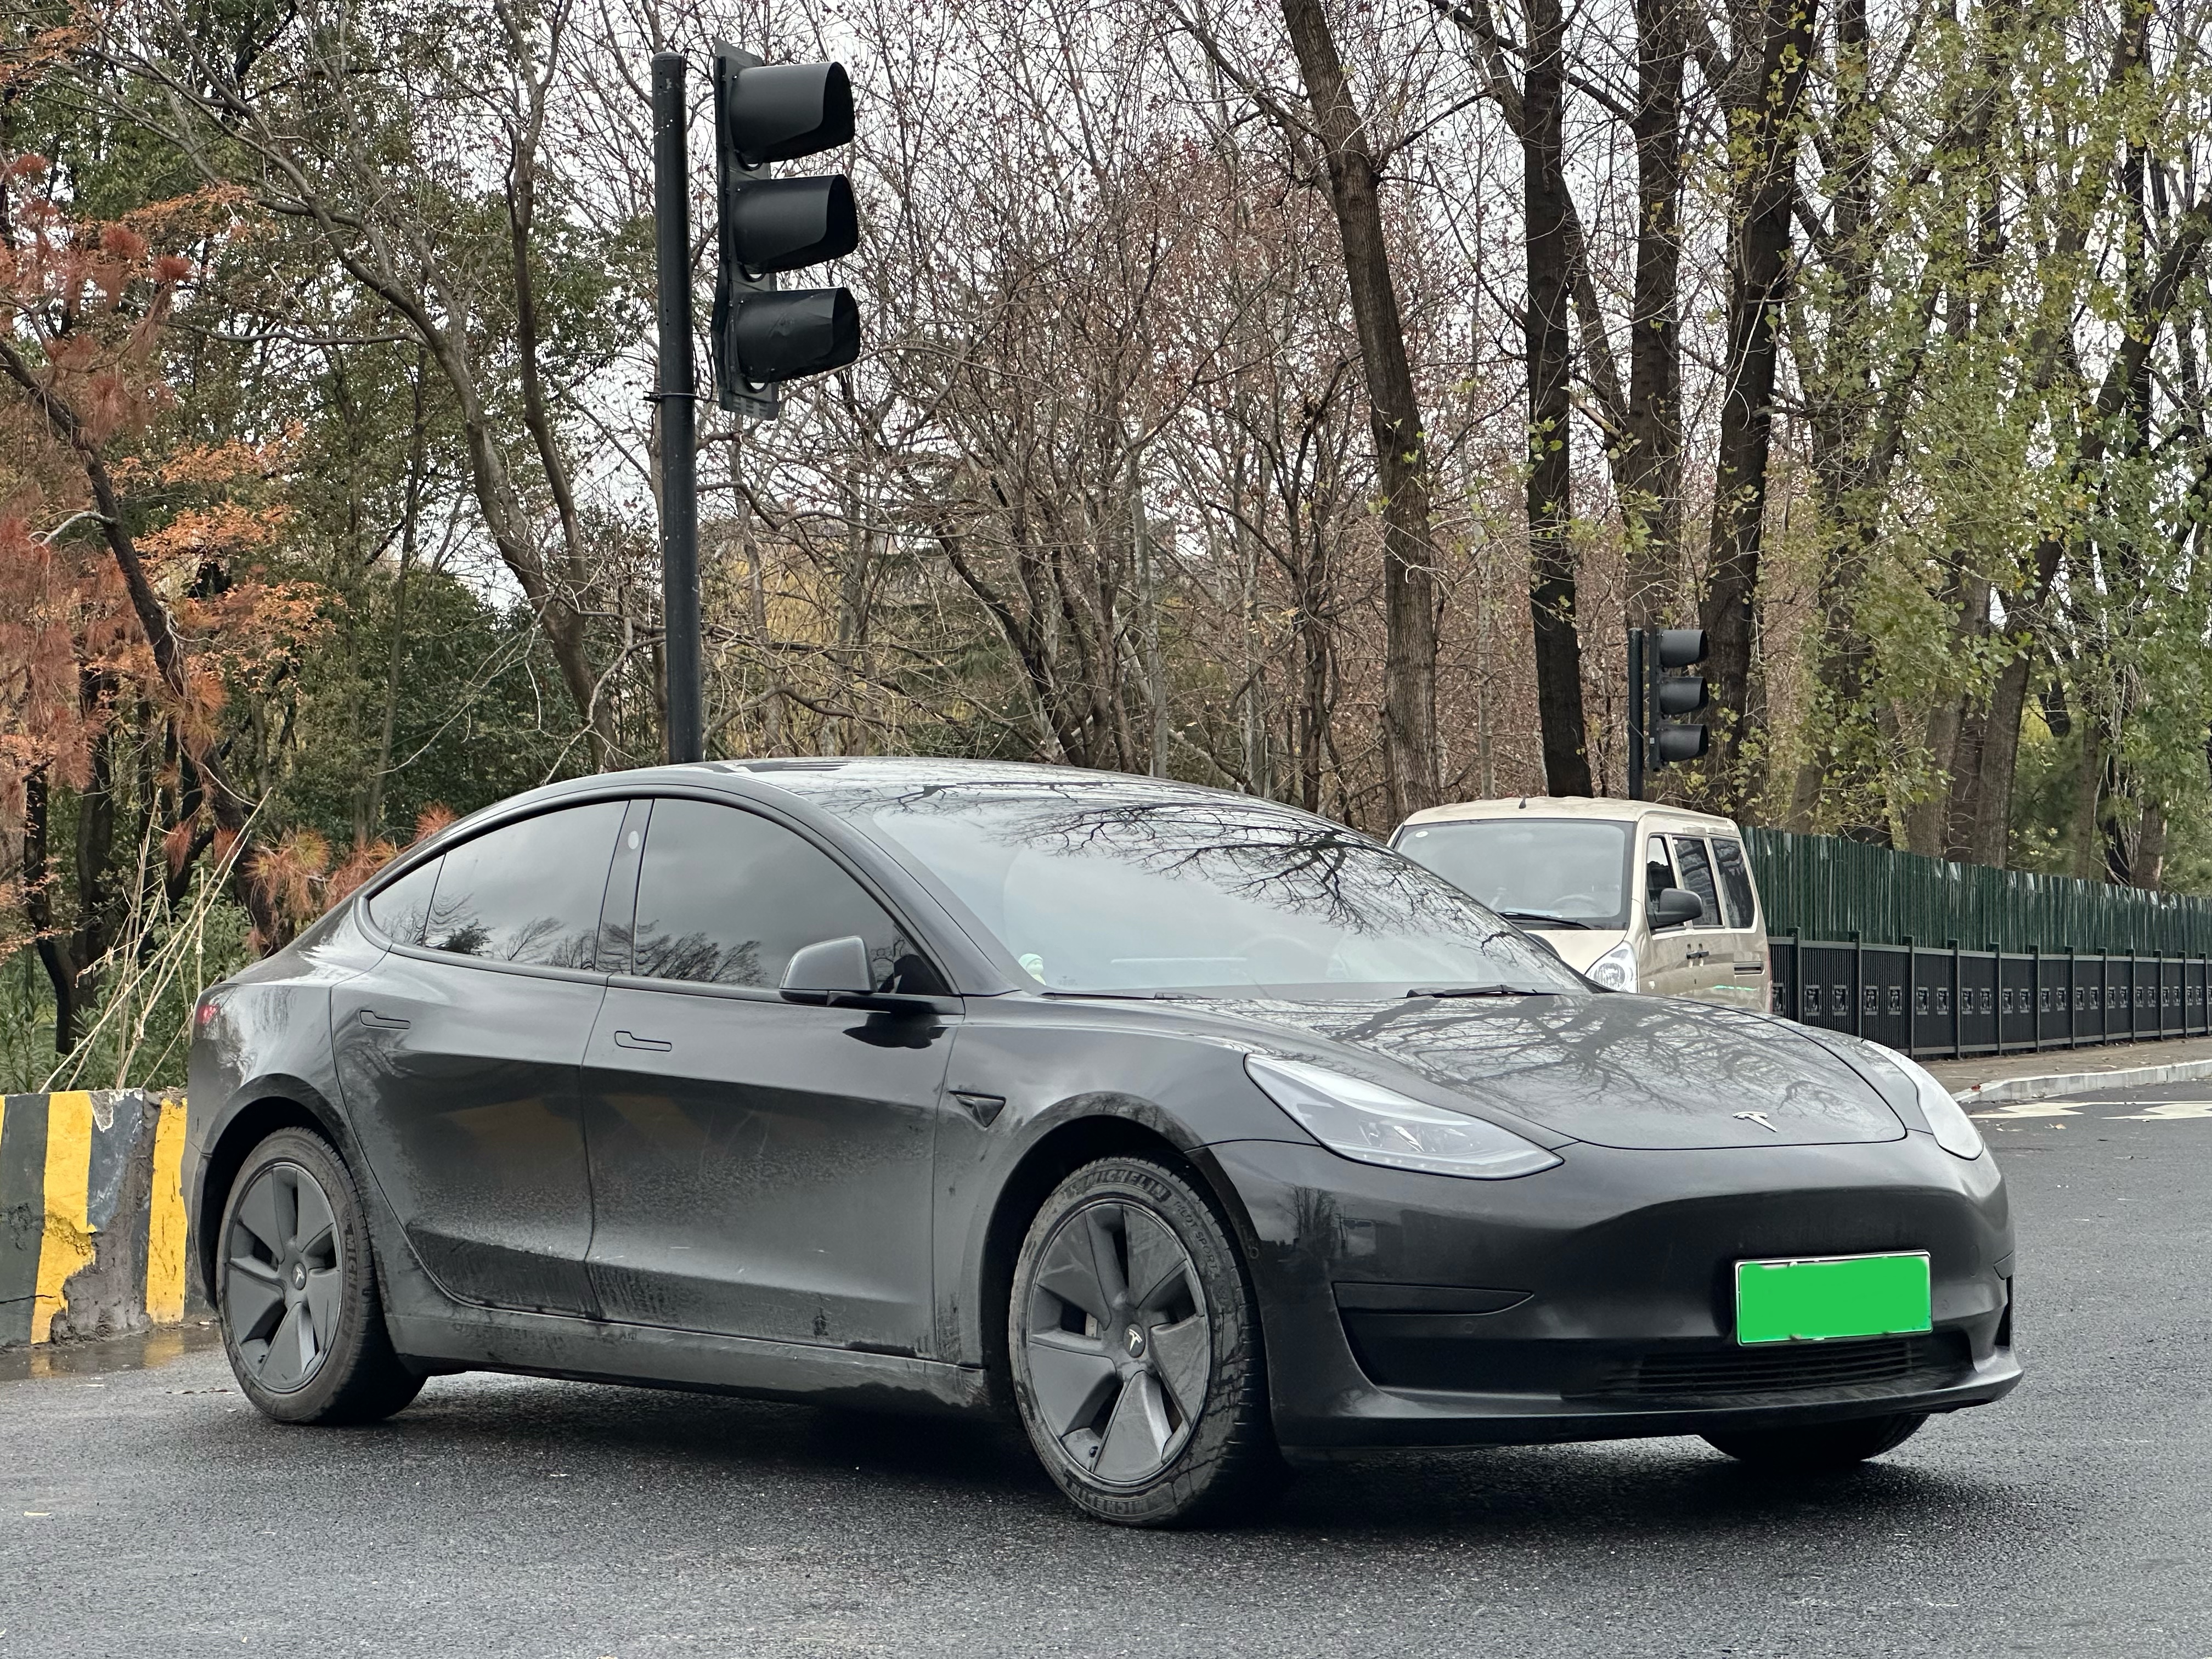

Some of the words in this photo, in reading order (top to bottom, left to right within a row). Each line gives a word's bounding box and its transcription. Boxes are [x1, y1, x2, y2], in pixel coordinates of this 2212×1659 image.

[1086, 1170, 1168, 1200] MICHELIN
[1173, 1201, 1198, 1228] PILOT
[1195, 1231, 1218, 1269] SPORT
[1070, 1482, 1148, 1514] MICHELIN
